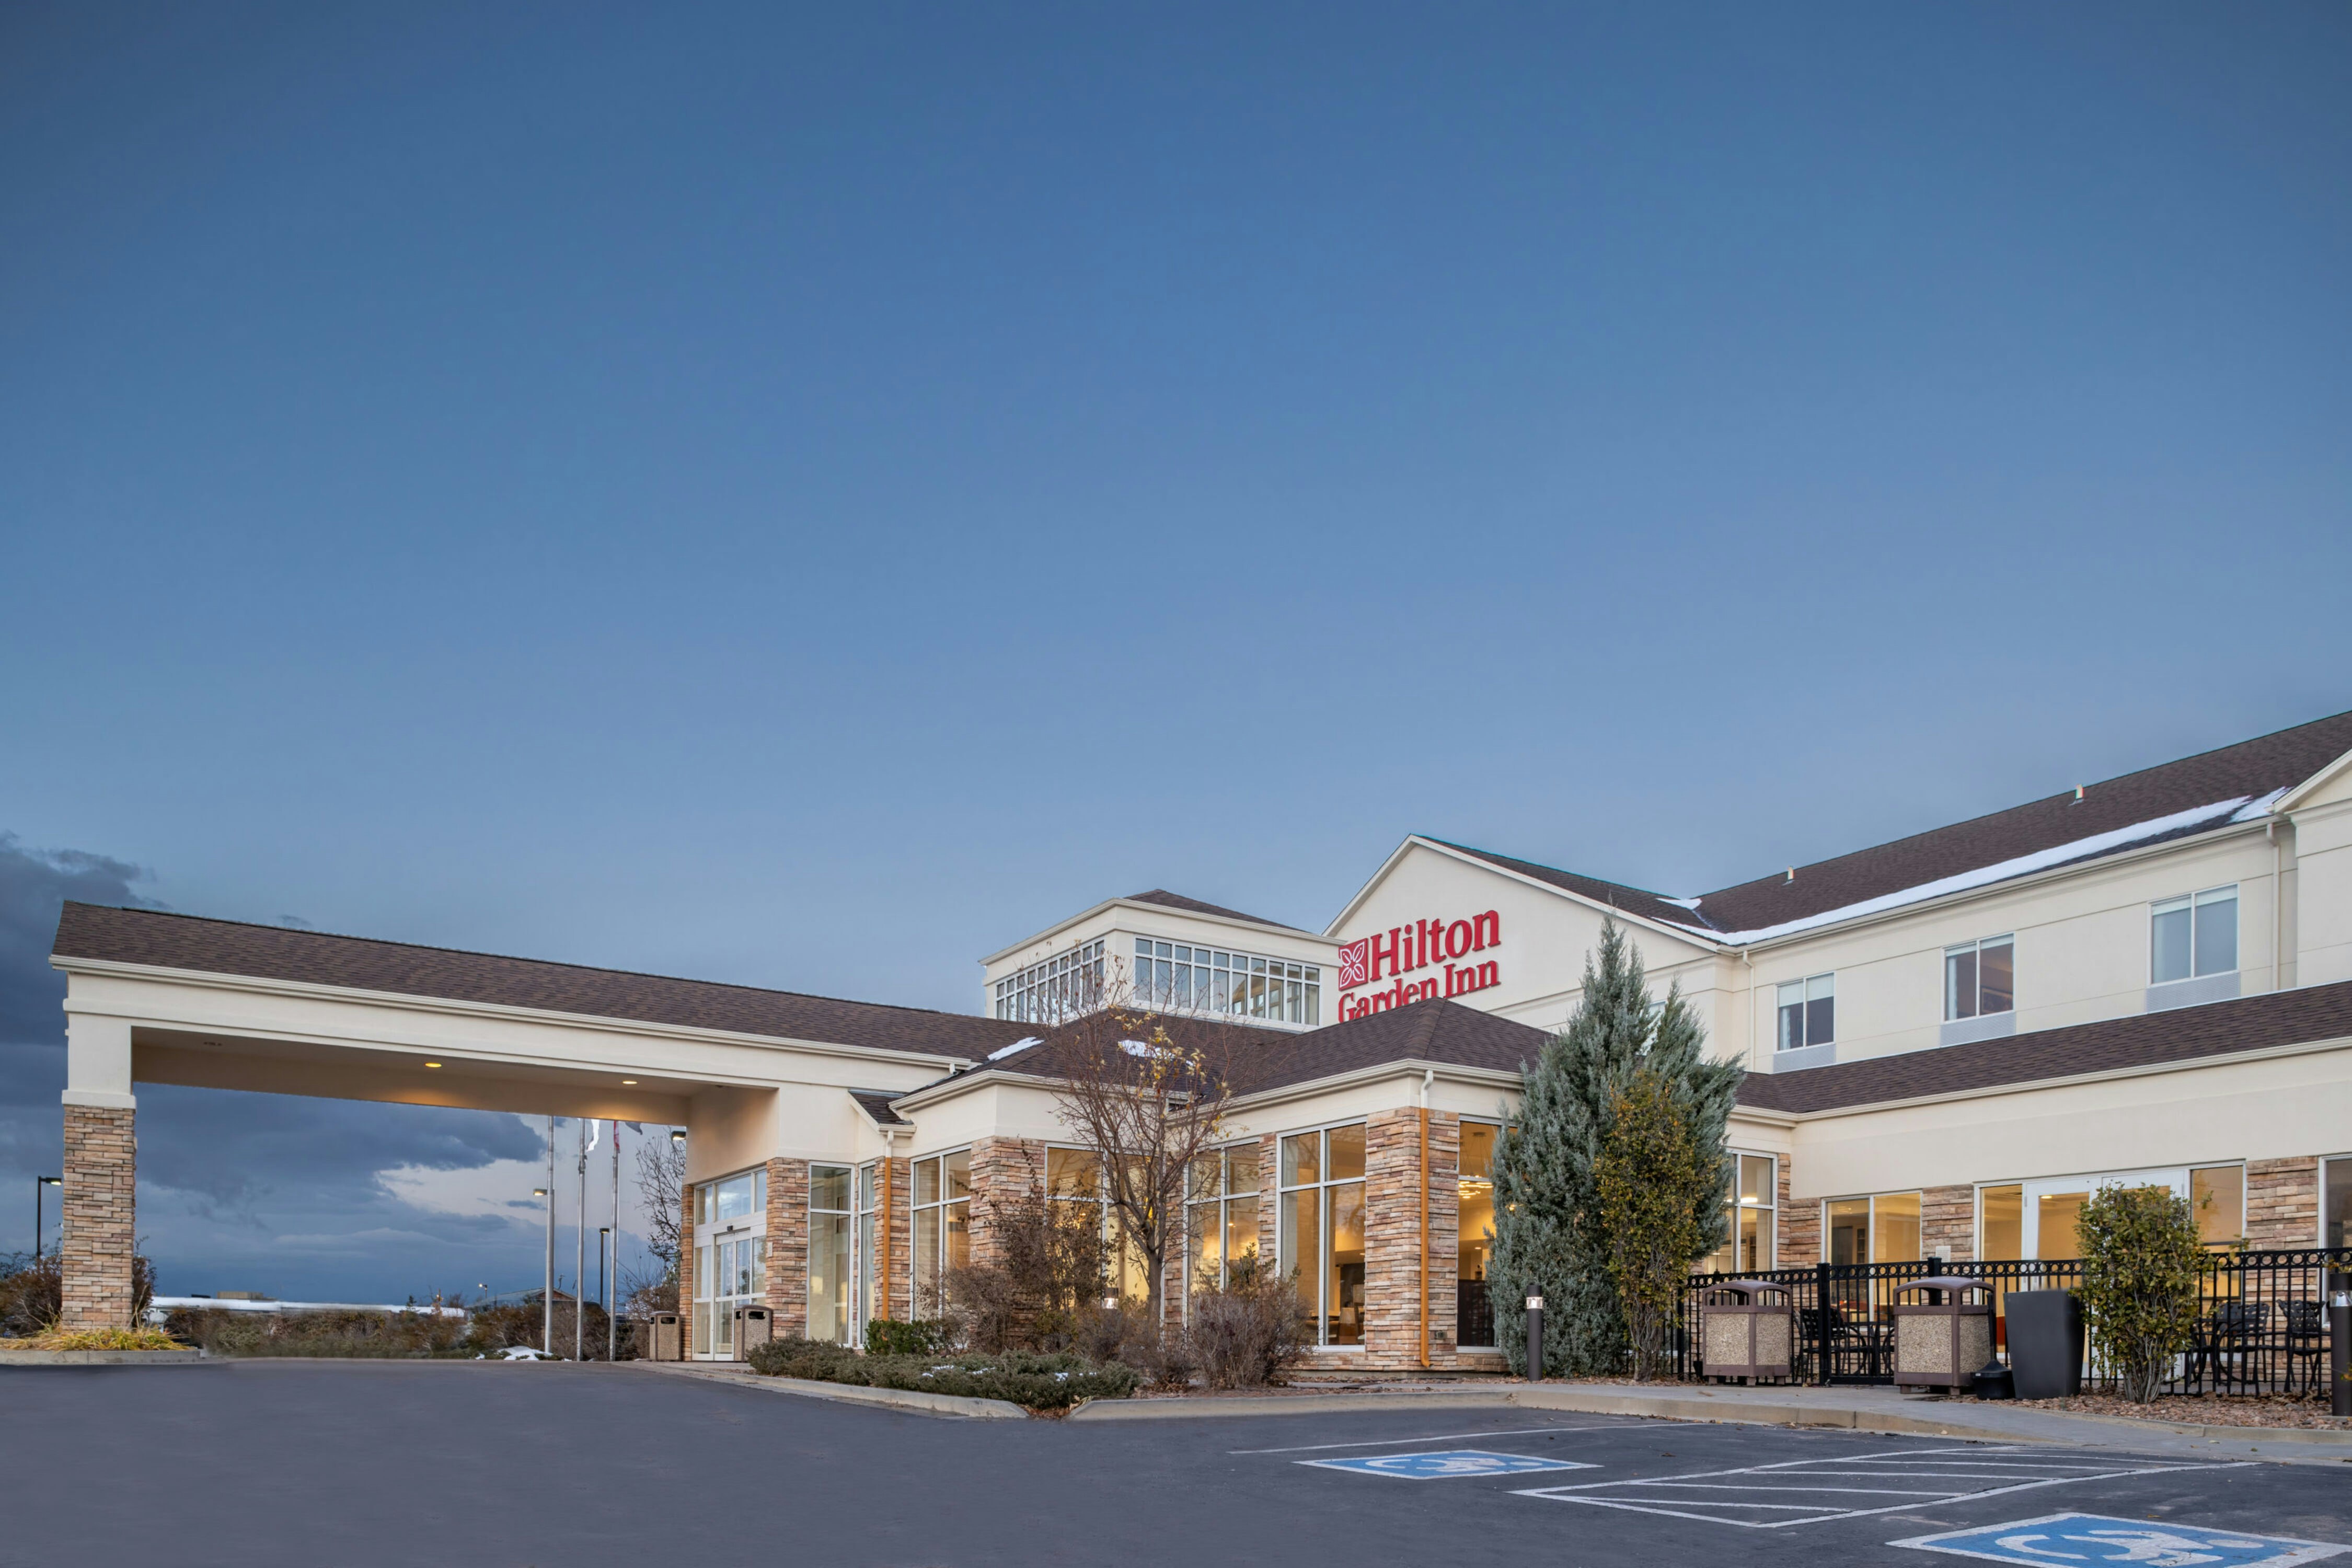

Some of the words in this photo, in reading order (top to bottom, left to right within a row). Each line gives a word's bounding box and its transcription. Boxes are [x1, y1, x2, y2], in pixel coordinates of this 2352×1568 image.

[1370, 910, 1501, 981] Hilton
[1338, 977, 1438, 1023] Garden
[1443, 960, 1501, 998] Inn
